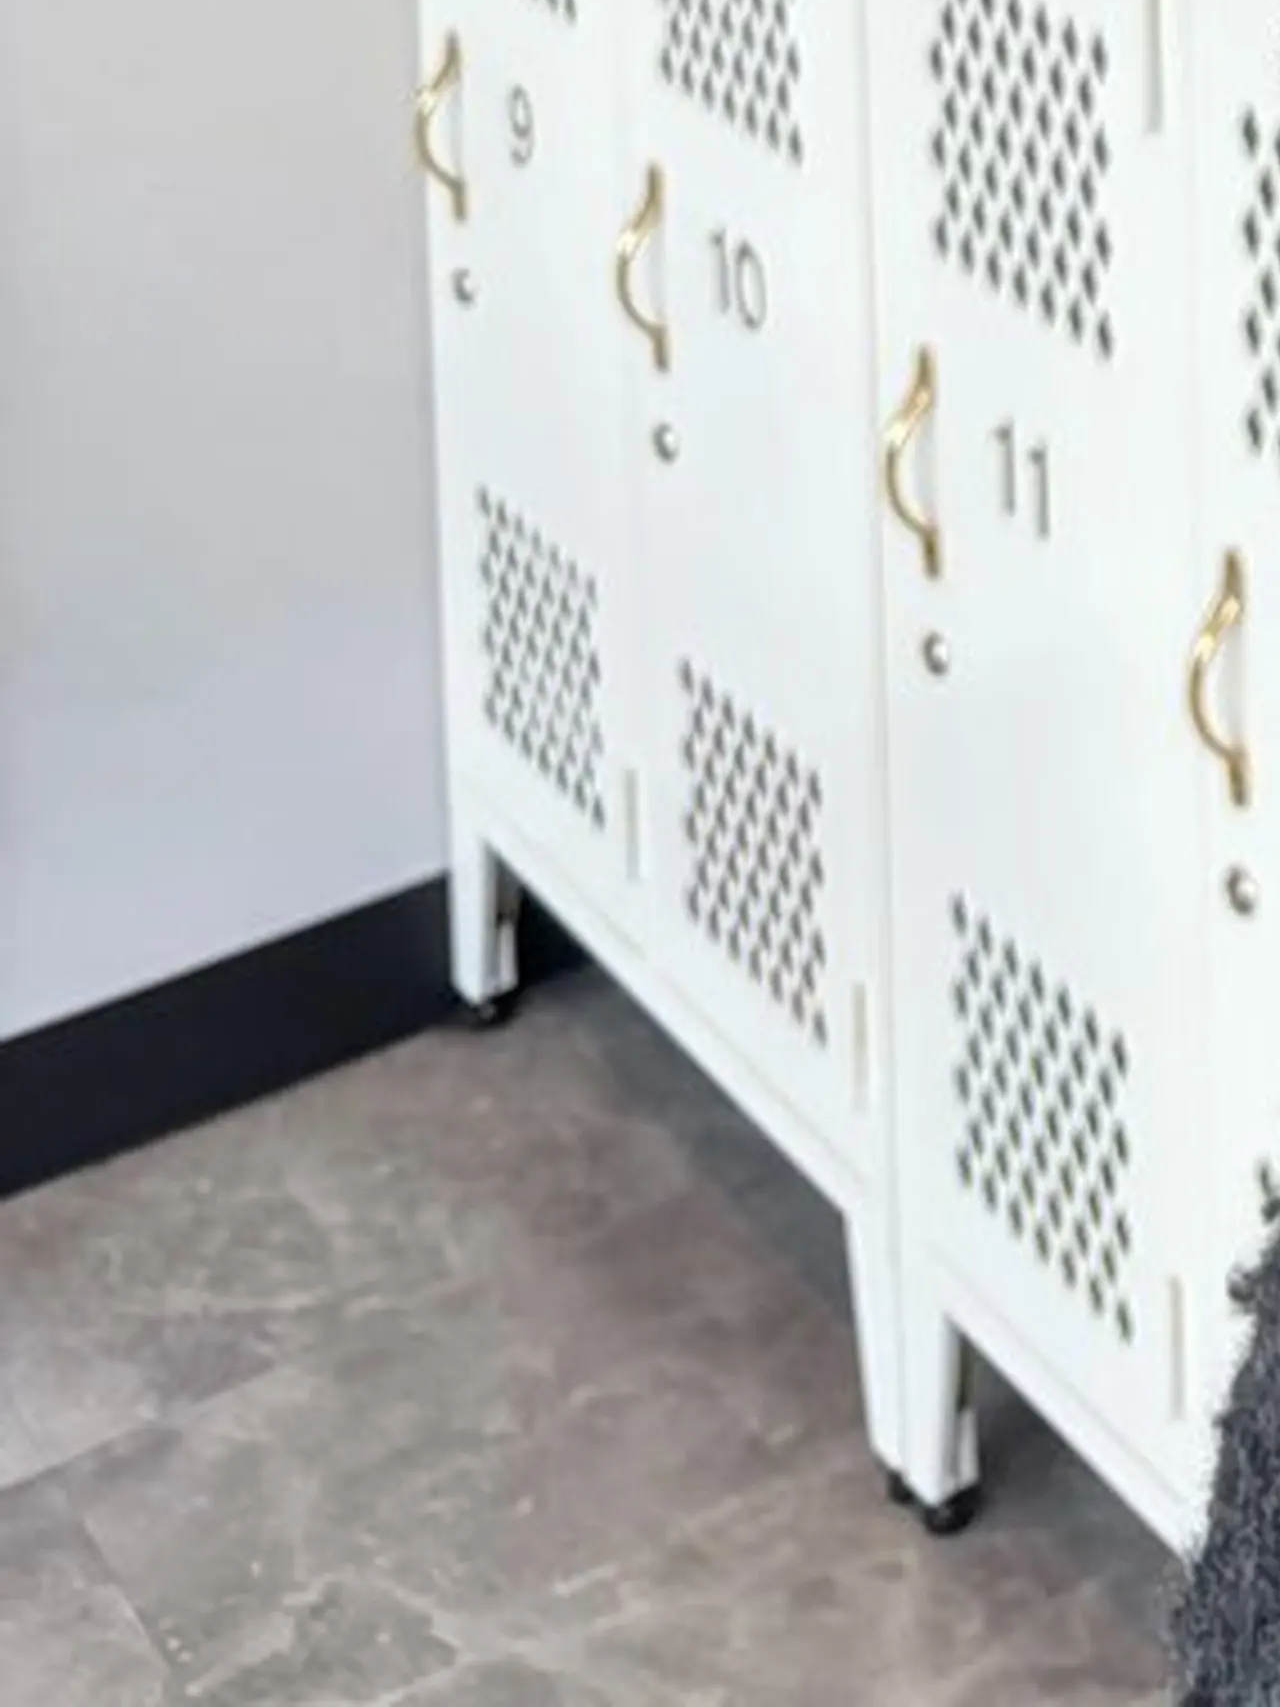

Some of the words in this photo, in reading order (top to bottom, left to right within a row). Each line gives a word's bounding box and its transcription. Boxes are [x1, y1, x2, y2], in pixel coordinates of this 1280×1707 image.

[506, 85, 534, 167] 9
[709, 227, 768, 331] 10
[992, 420, 1051, 539] 11
